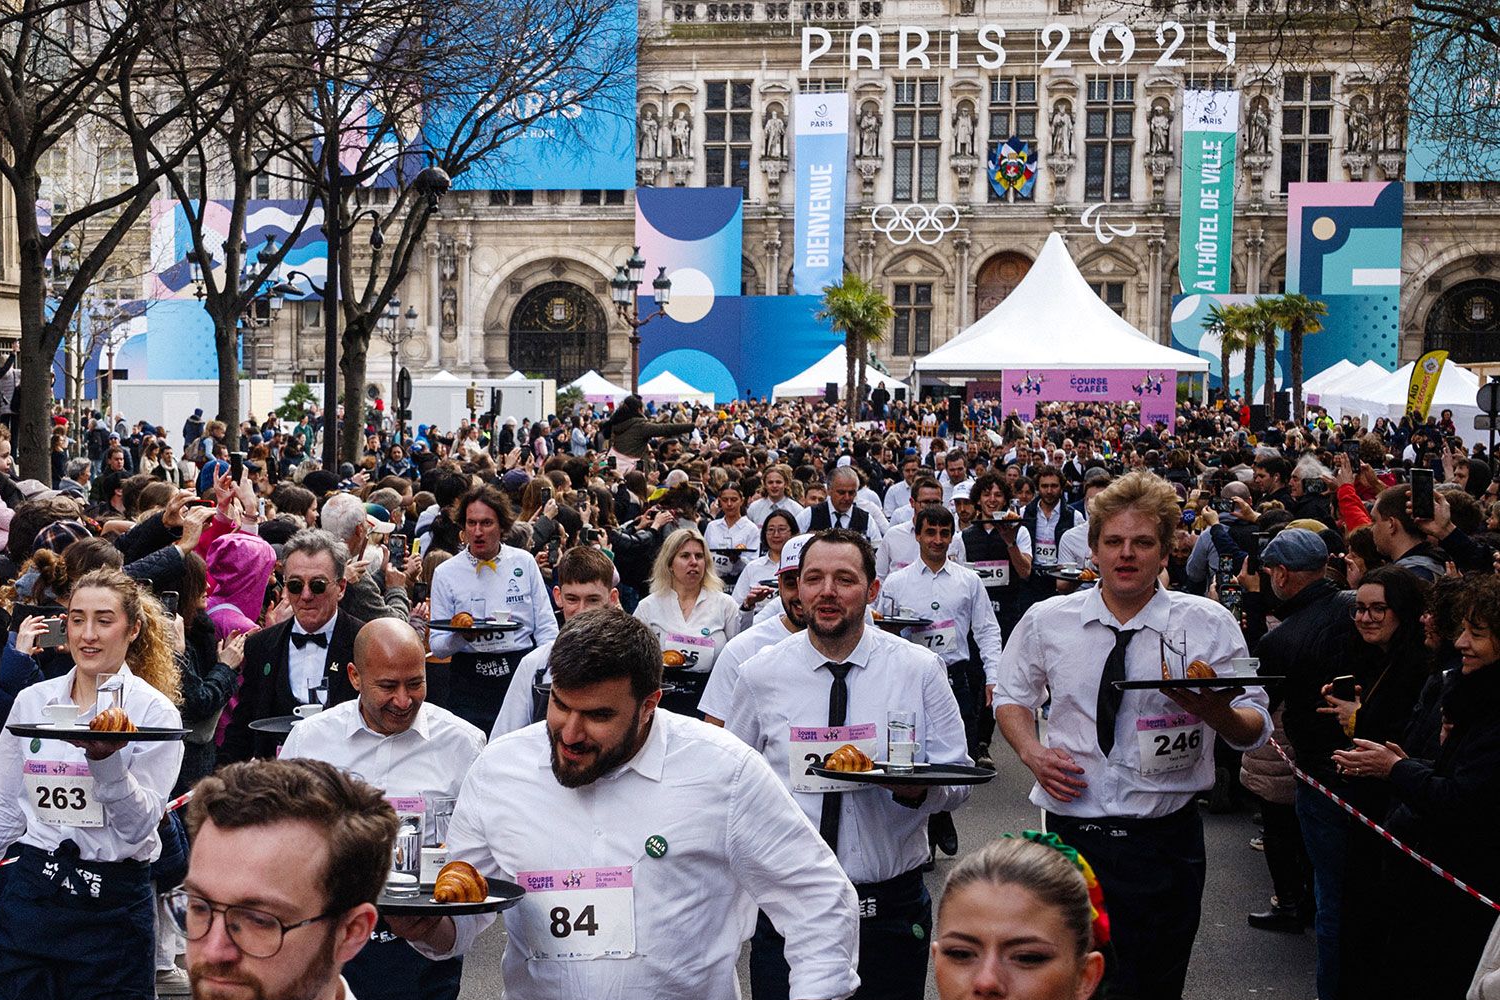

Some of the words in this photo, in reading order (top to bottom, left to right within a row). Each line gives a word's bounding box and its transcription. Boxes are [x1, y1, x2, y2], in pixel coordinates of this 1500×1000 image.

[802, 24, 1006, 71] PARIS
[1041, 20, 1236, 67] 2024
[811, 120, 833, 128] PARIS
[1199, 117, 1222, 125] PARIS
[1202, 140, 1222, 186] VILLE
[1200, 189, 1219, 210] DE
[806, 164, 832, 268] BIENVENUE
[1195, 213, 1219, 277] L'HÔTEL
[1193, 280, 1215, 292] À
[1070, 377, 1108, 385] COURSE
[1036, 547, 1056, 557] 267
[925, 634, 945, 649] 72
[1153, 728, 1201, 757] 246
[36, 786, 87, 811] 263
[527, 875, 554, 884] COURSE
[550, 905, 599, 939] 84
